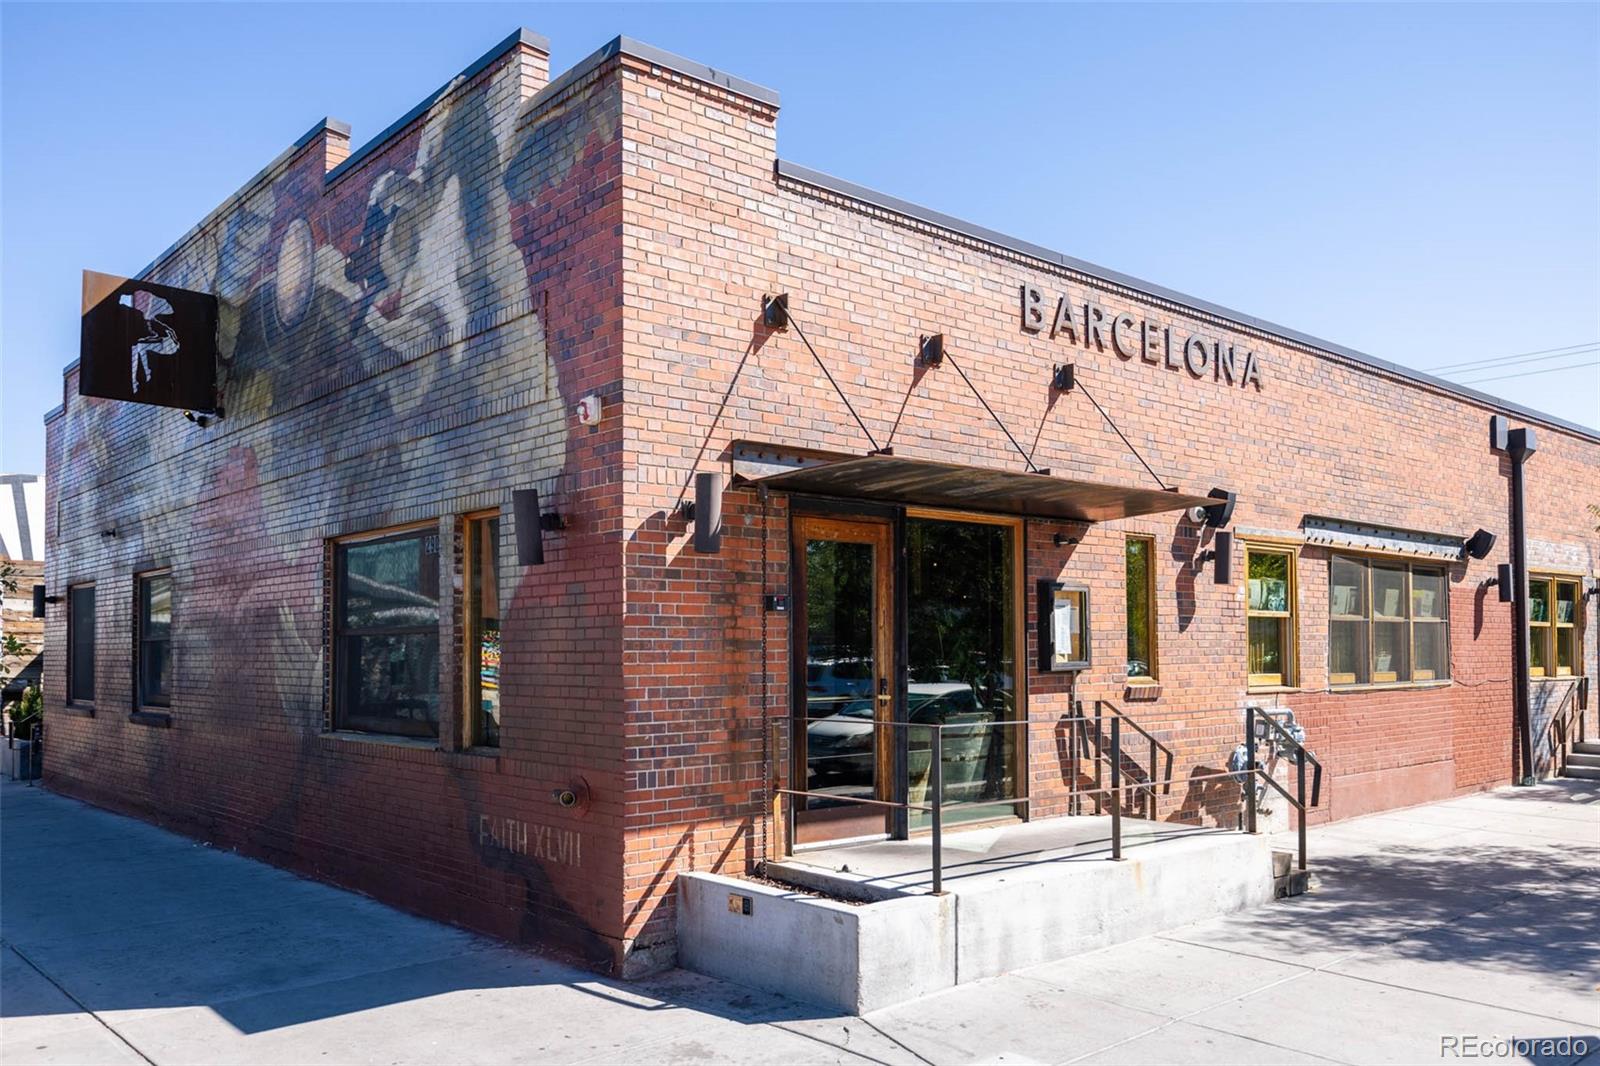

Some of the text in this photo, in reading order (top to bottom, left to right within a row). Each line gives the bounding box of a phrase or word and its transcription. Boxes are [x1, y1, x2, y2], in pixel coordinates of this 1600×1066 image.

[1020, 281, 1264, 392] BARCELONA
[480, 815, 581, 867] FAITH XLVII
